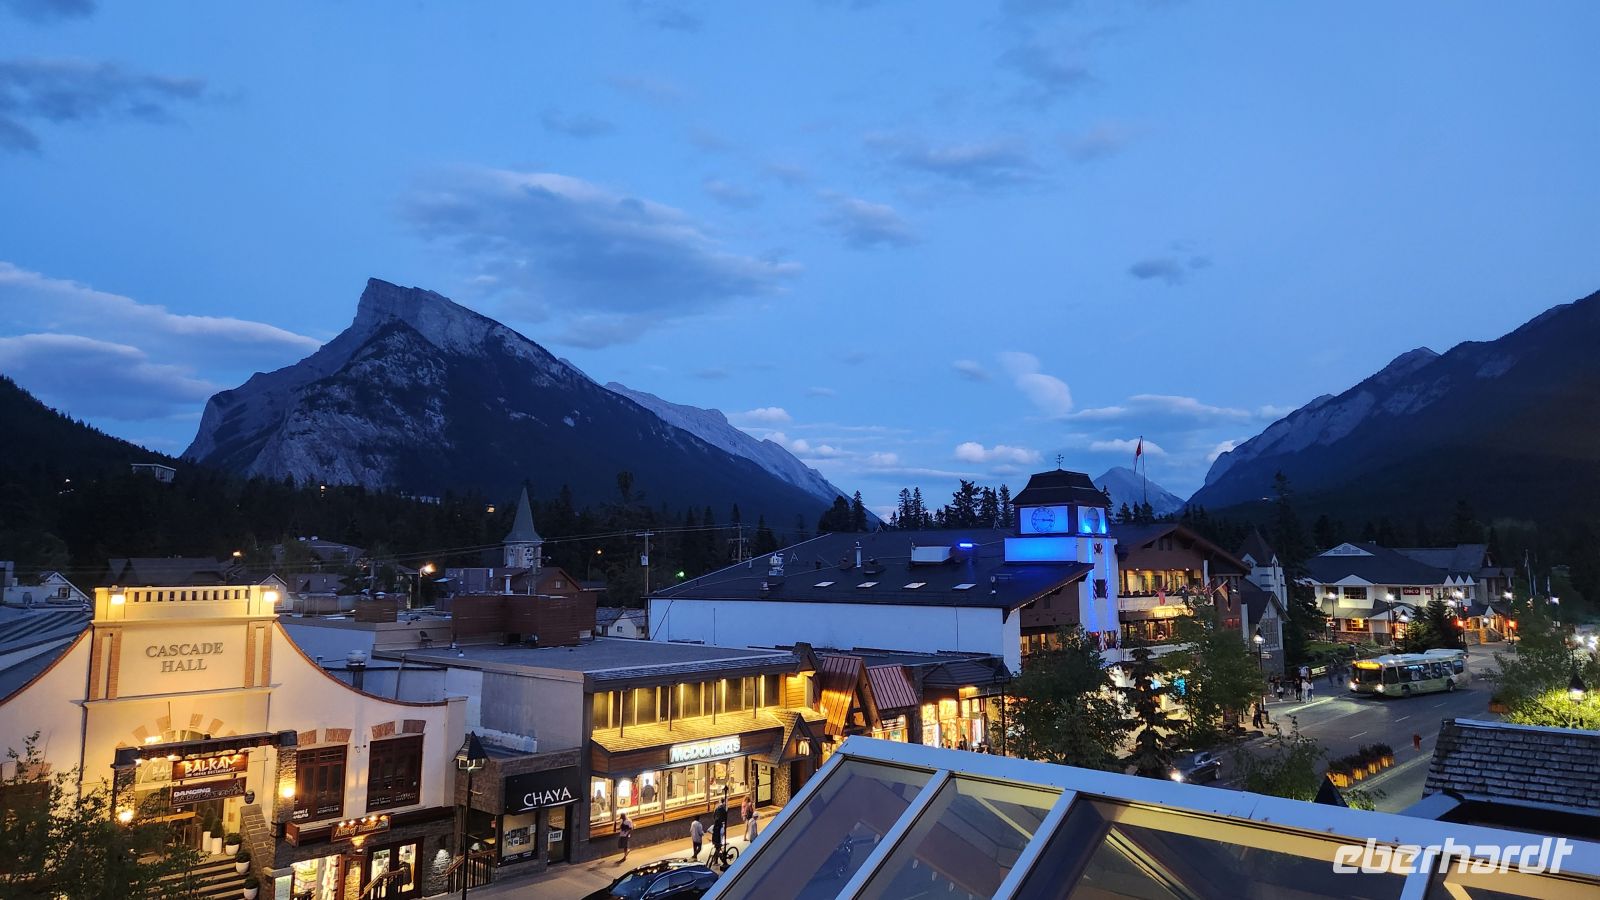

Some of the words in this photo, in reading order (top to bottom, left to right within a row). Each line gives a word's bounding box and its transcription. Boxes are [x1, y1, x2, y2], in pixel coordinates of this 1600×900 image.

[145, 642, 224, 658] CASCADE
[161, 658, 207, 673] HALL
[173, 787, 211, 798] DANCING
[523, 786, 572, 807] CHAYA
